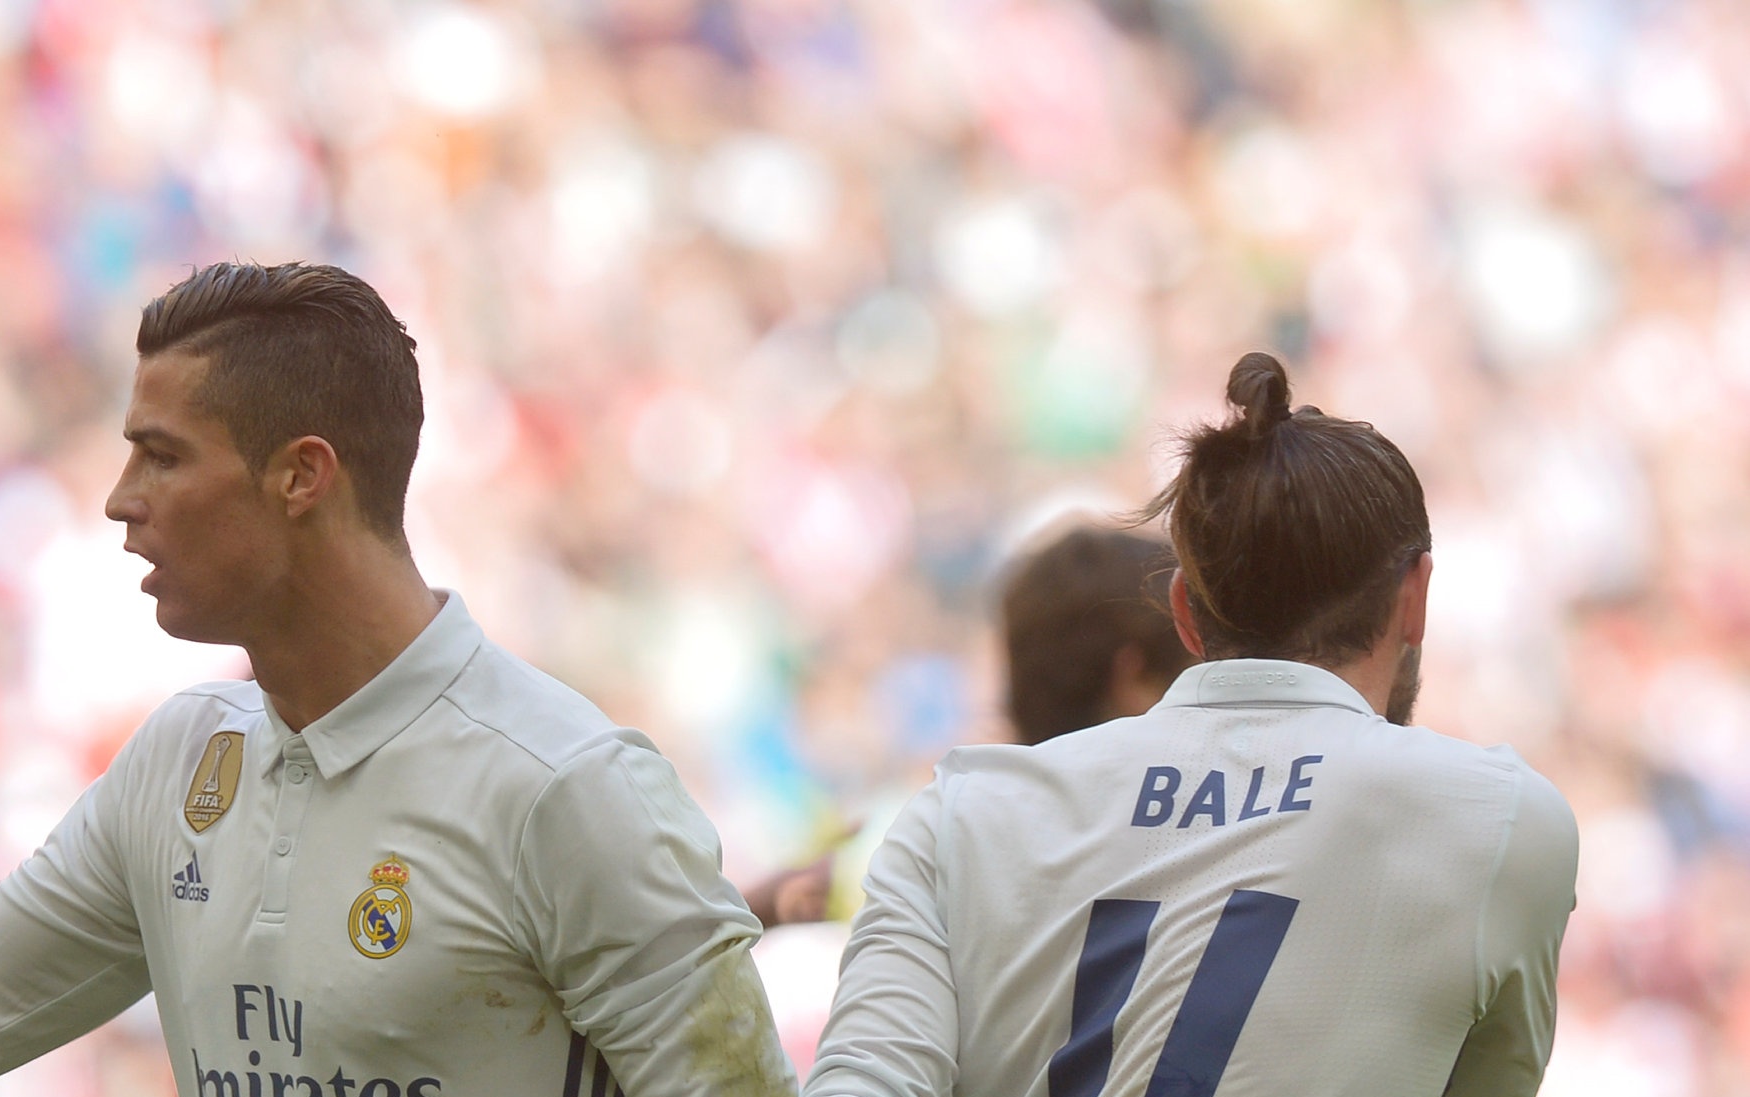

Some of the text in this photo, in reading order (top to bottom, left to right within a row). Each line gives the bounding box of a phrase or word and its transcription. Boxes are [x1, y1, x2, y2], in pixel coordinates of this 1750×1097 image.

[193, 794, 220, 808] FIFA
[1131, 755, 1324, 828] BALE
[233, 984, 303, 1057] Fly
